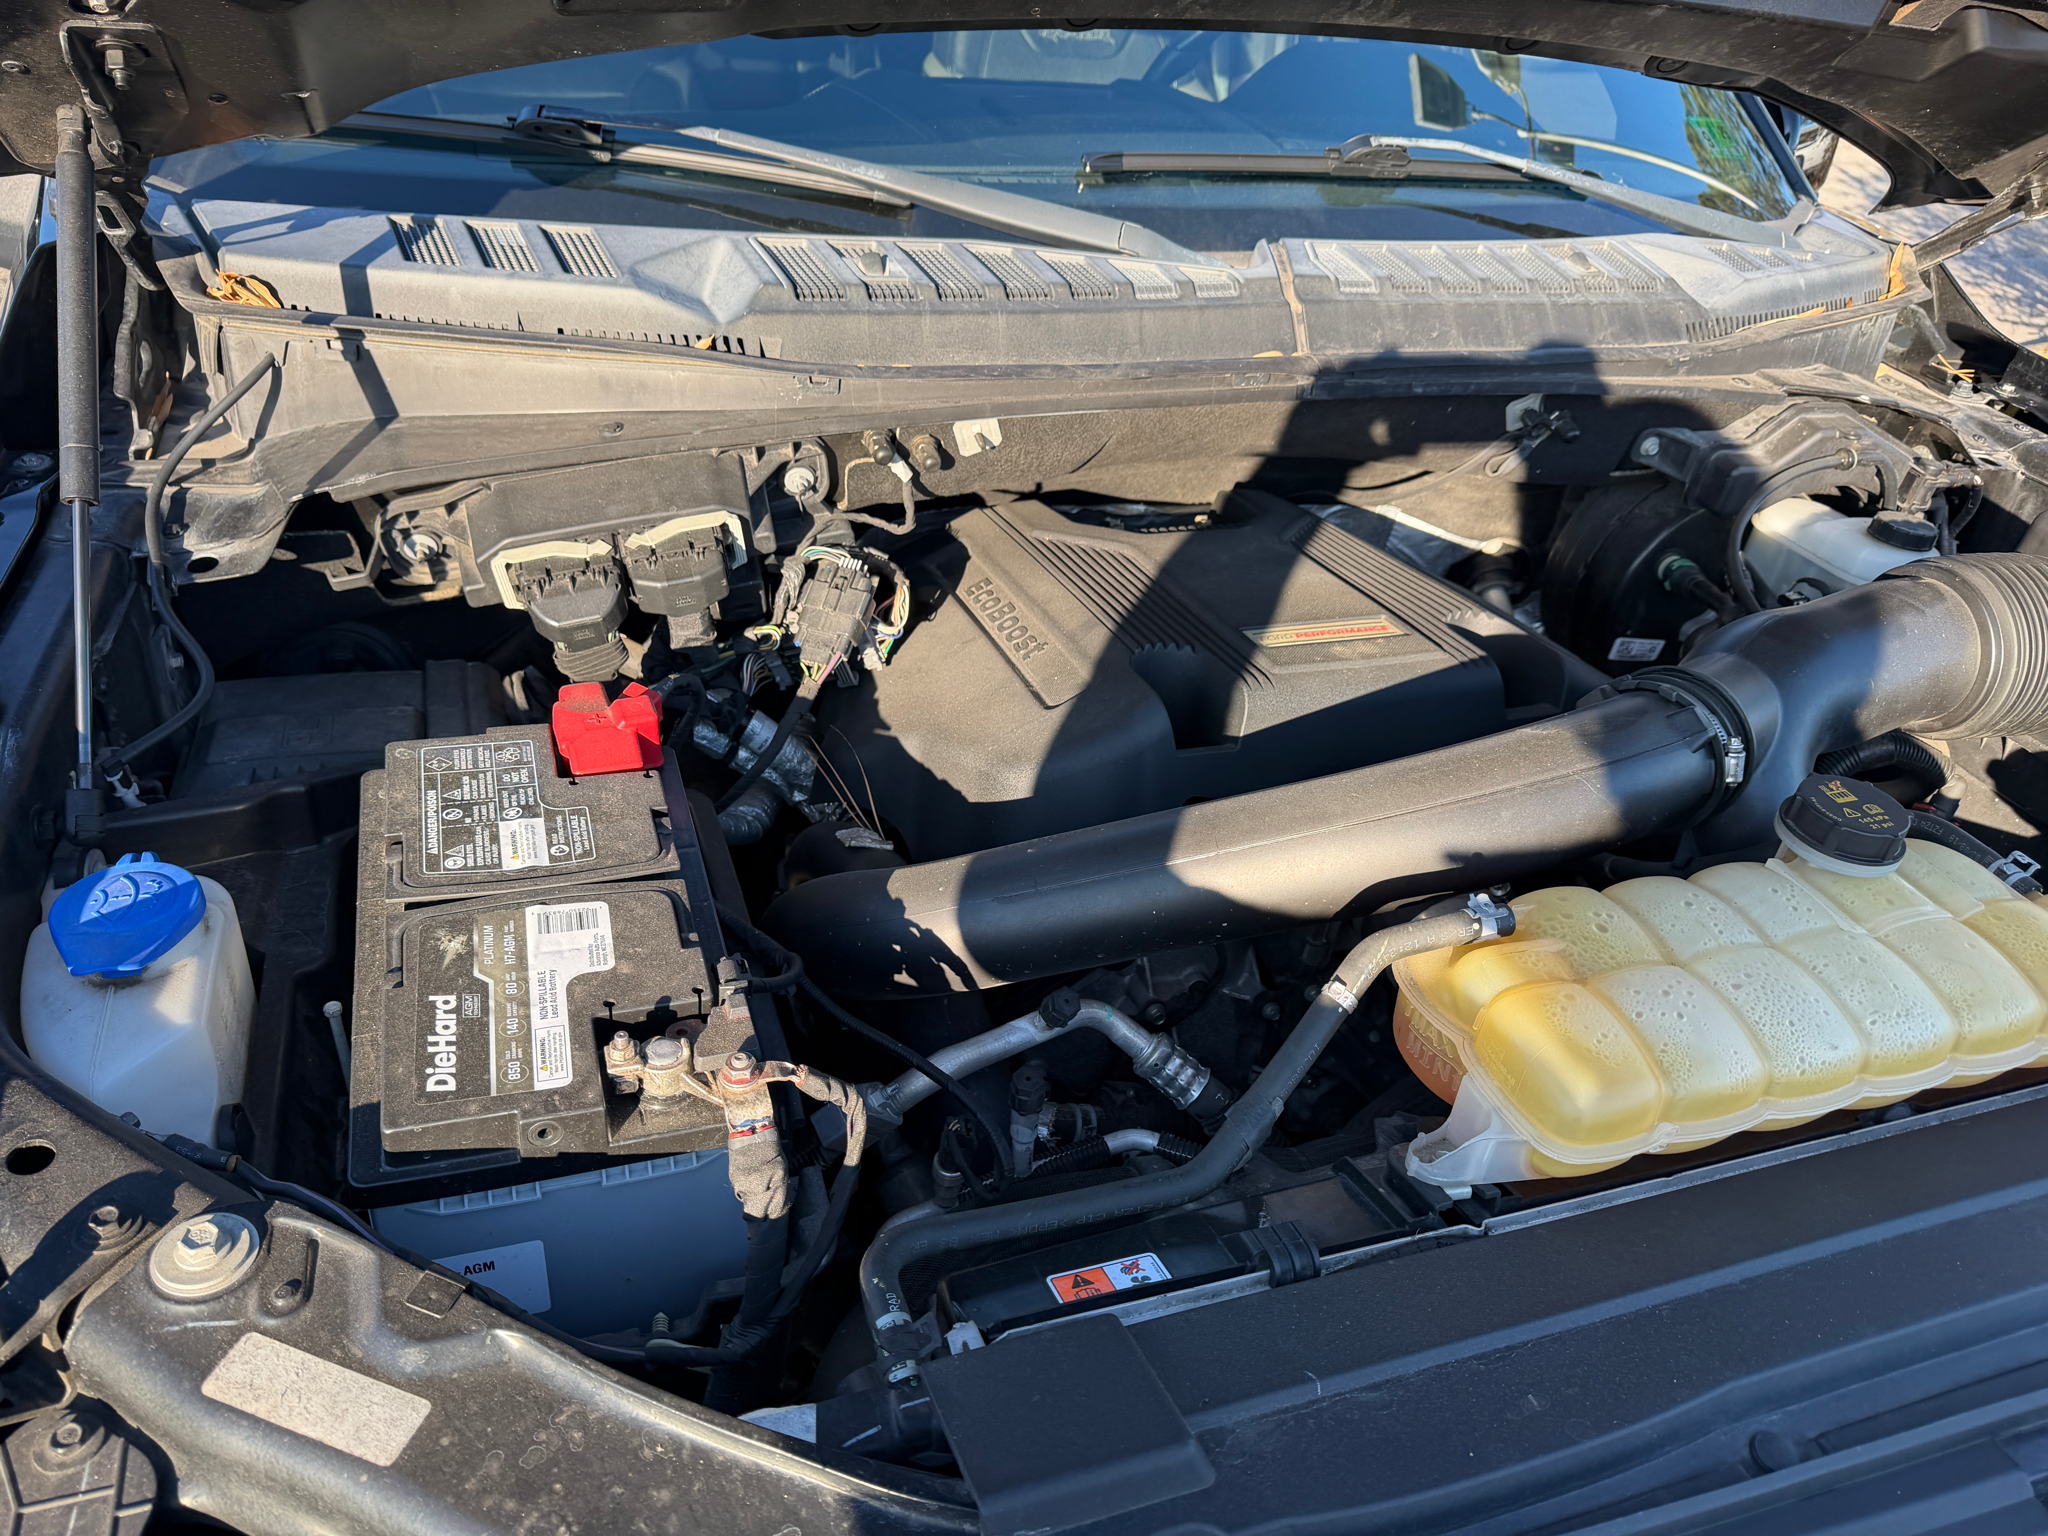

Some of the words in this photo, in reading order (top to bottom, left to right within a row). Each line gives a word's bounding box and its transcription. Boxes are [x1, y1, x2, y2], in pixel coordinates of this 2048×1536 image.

[964, 577, 1049, 661] EcoBoost
[1256, 633, 1290, 642] FORD
[1292, 625, 1388, 638] PERFORMANCE
[502, 774, 511, 782] DO
[511, 772, 519, 782] NOT
[427, 790, 438, 848] DANGER/POISON
[1858, 817, 1873, 826] 145
[1881, 821, 1894, 830] psi
[570, 815, 583, 854] NON-SPILLABLE
[483, 925, 494, 964] PLATINUM
[504, 934, 517, 965] H7-AGM
[505, 982, 517, 994] 80
[547, 970, 557, 991] Battery
[537, 970, 549, 1020] NON-SPILLABLE
[549, 992, 558, 1003] Acid
[464, 996, 473, 1016] AGM
[550, 1005, 559, 1019] Lead
[506, 1018, 519, 1035] 140
[1411, 1011, 1453, 1058] MAX
[425, 995, 457, 1092] DieHard
[539, 1037, 547, 1065] WARNING:
[1406, 1031, 1451, 1082] MIN
[507, 1061, 521, 1080] 850
[886, 1292, 901, 1312] RAD
